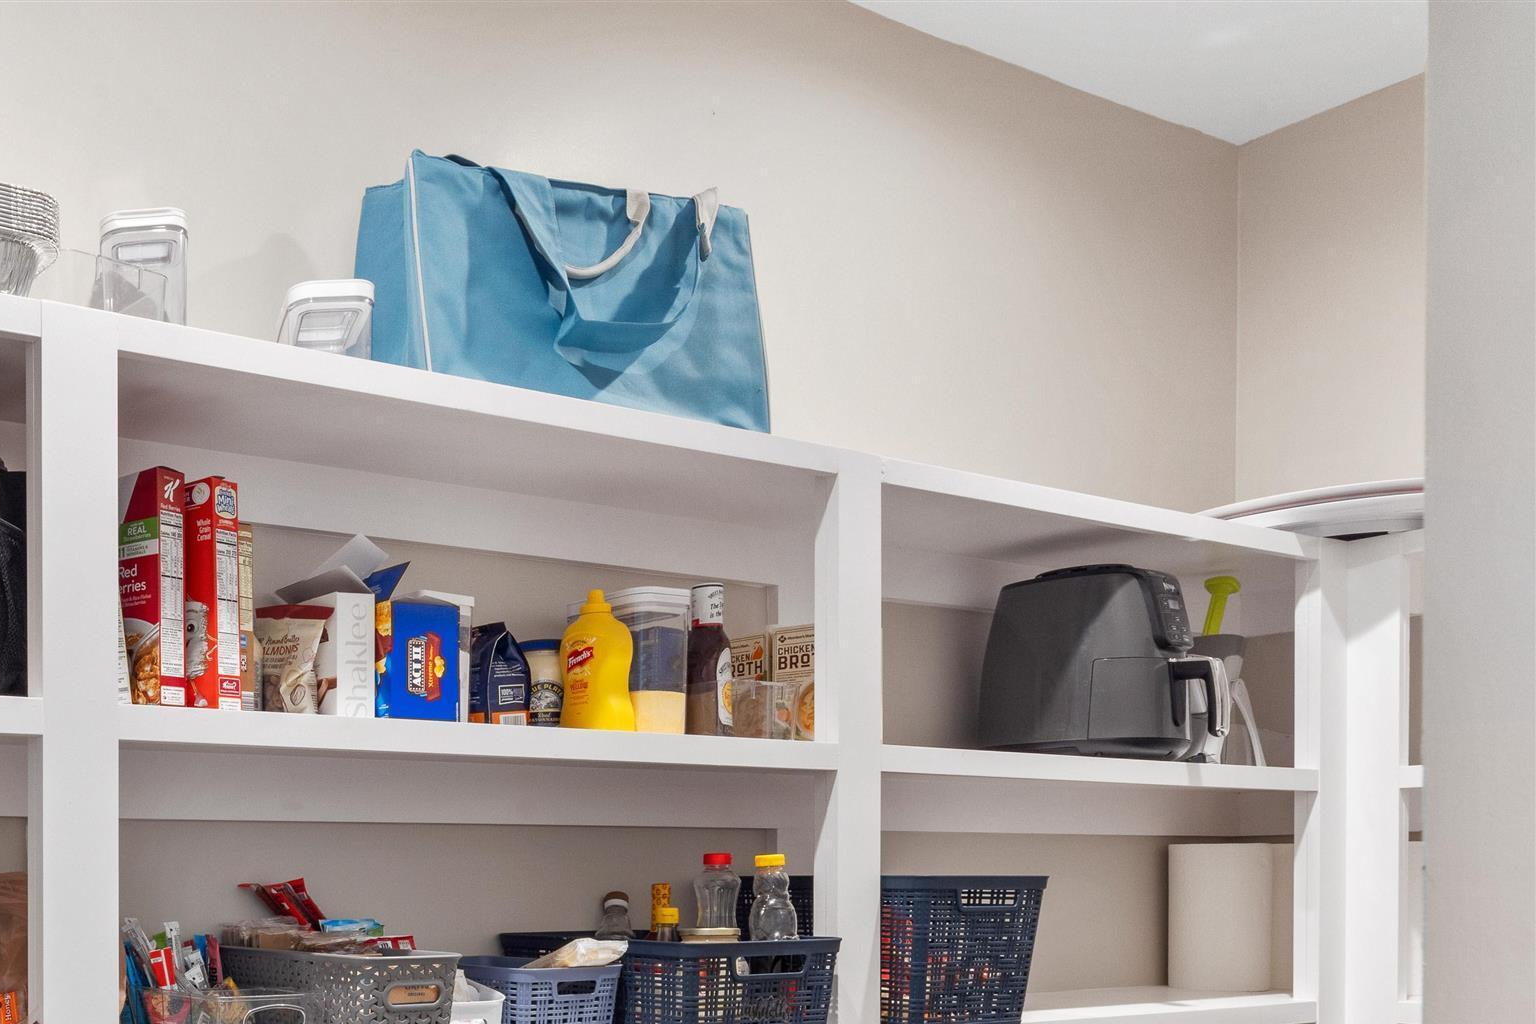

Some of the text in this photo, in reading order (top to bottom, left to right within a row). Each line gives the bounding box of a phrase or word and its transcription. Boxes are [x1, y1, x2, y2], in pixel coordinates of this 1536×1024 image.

[164, 478, 180, 502] K
[127, 525, 147, 536] REAL
[119, 564, 138, 578] Red
[119, 580, 146, 593] erries
[344, 602, 368, 717] Shaklee
[568, 649, 592, 668] French's
[731, 654, 752, 664] CKEN
[777, 654, 814, 670] BRO
[412, 661, 422, 687] ACT
[731, 661, 763, 678] ROTH
